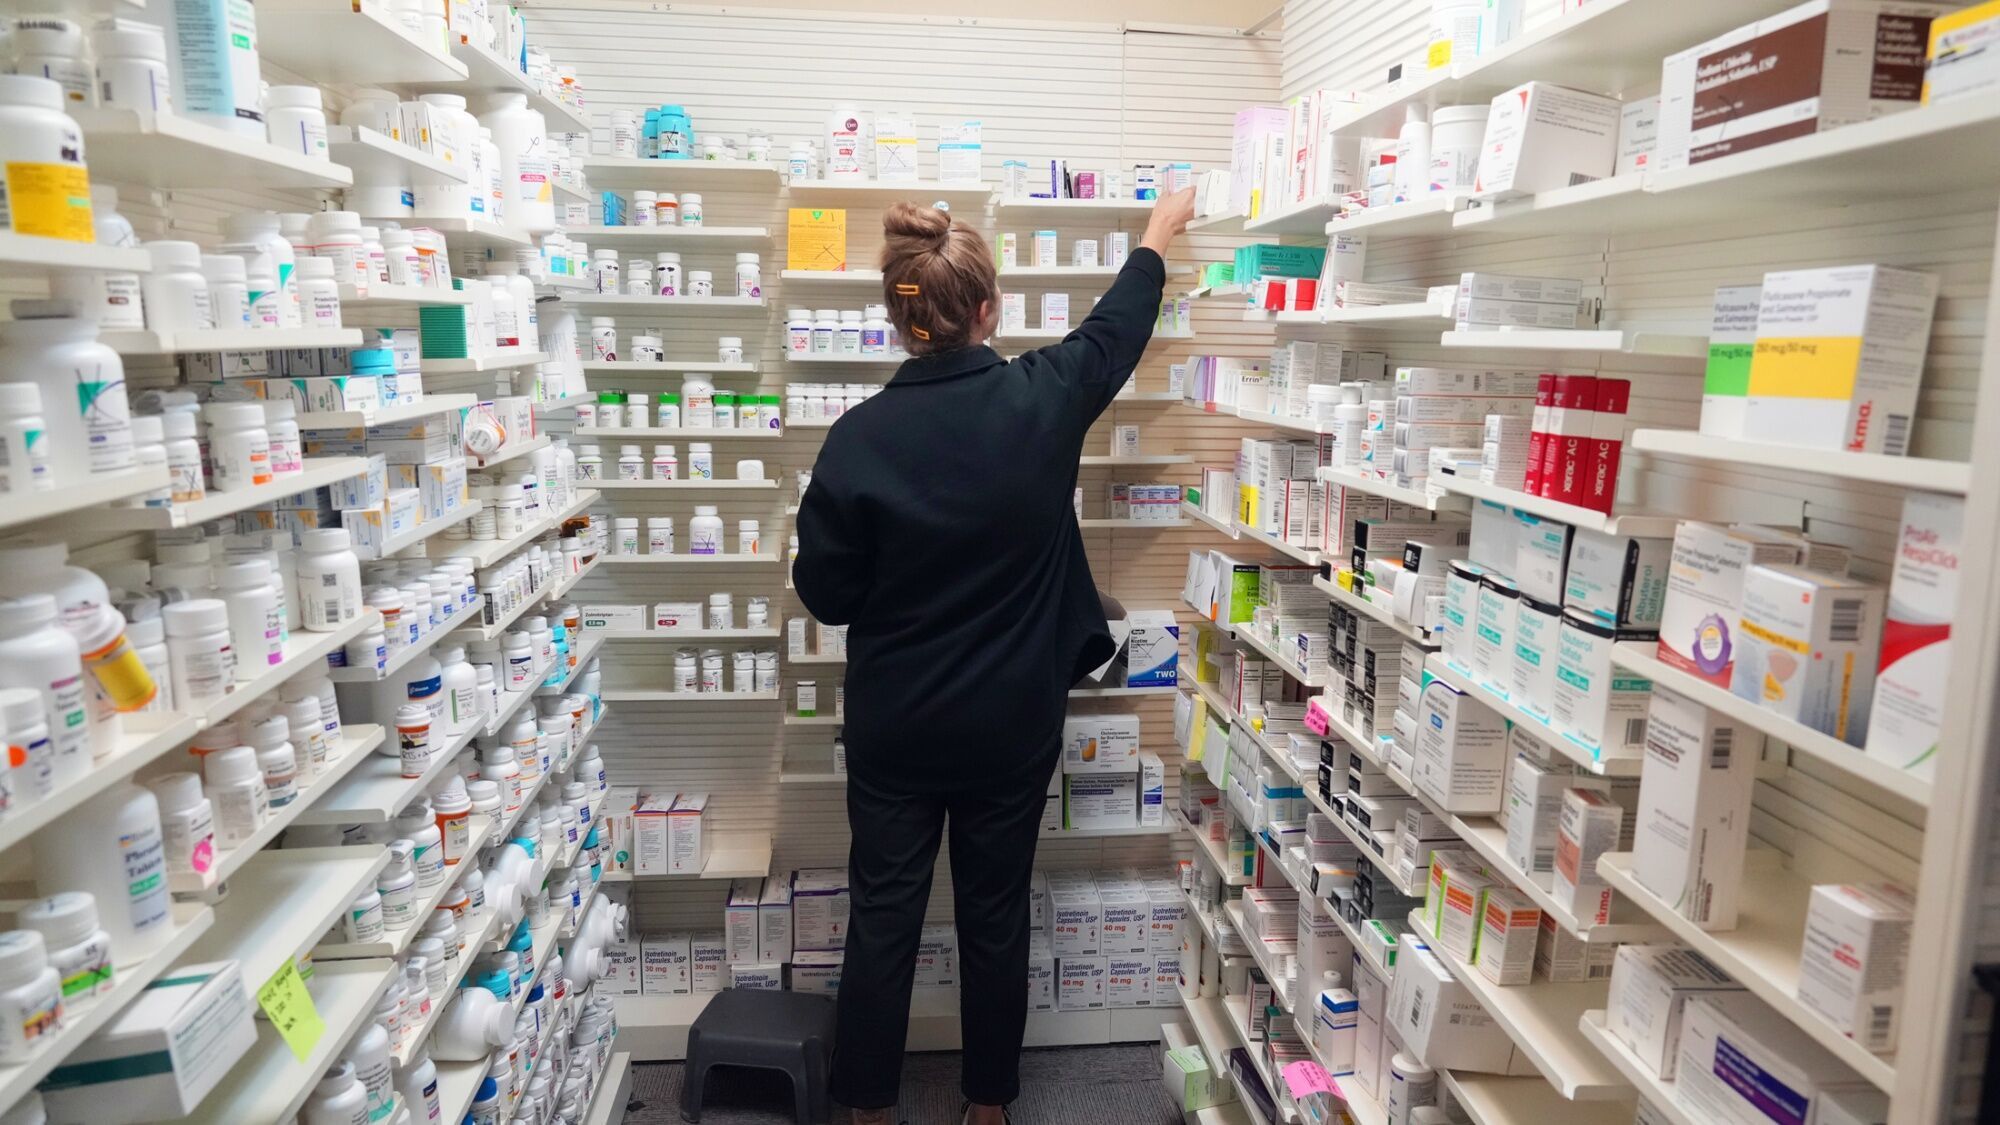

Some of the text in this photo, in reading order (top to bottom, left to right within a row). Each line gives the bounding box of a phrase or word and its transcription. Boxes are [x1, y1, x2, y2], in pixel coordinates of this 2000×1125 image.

[1635, 564, 1653, 622] Albuterol
[1155, 670, 1176, 678] TWO
[1104, 908, 1137, 916] Isotretinoin
[1152, 907, 1185, 915] Isotretinoin
[1133, 914, 1146, 922] USP
[1063, 963, 1095, 971] Isotretinoin
[1139, 967, 1151, 975] USP
[1091, 969, 1104, 977] USP
[735, 974, 769, 982] Isotretinoin
